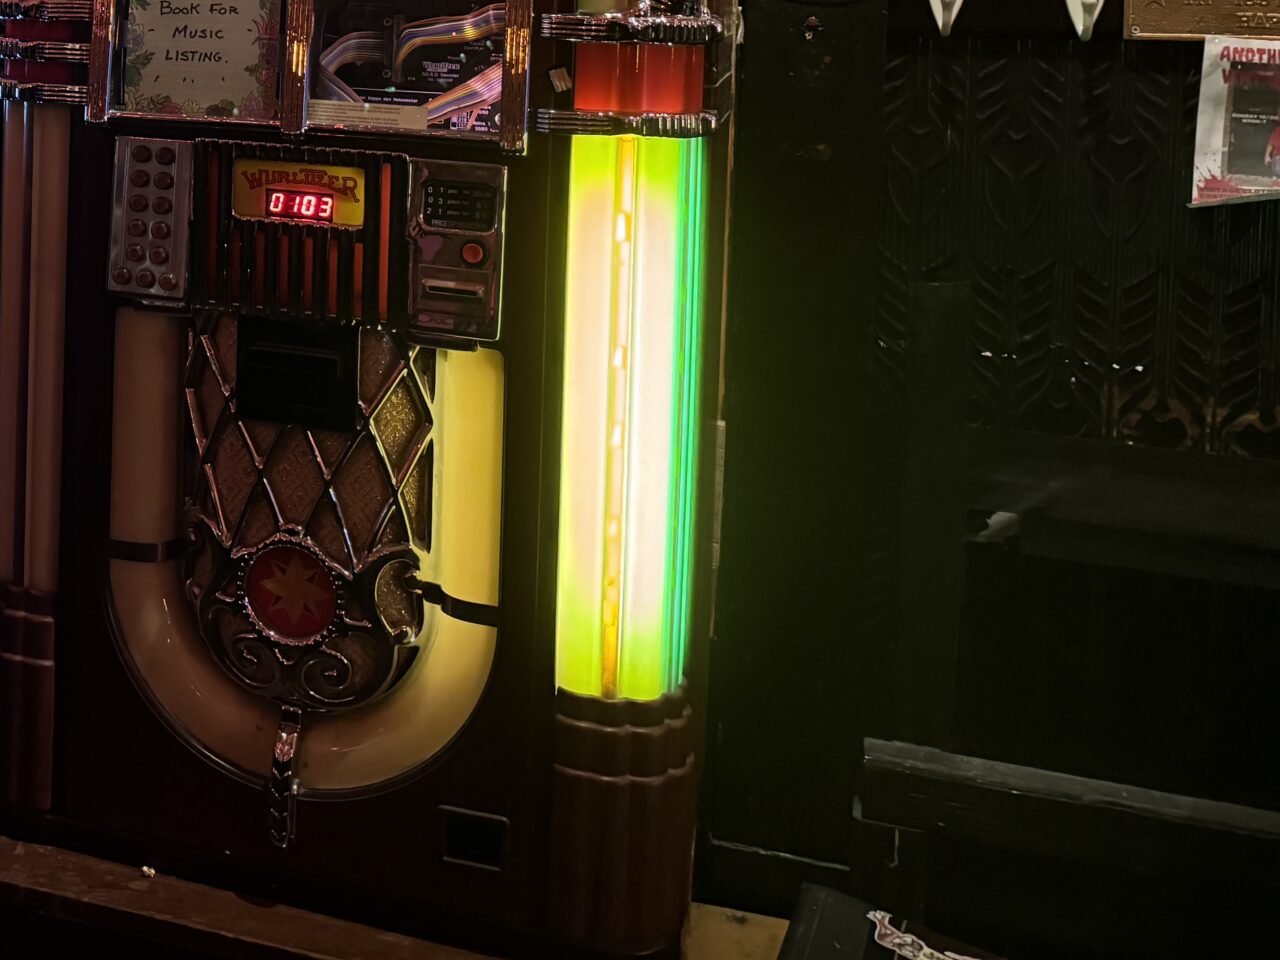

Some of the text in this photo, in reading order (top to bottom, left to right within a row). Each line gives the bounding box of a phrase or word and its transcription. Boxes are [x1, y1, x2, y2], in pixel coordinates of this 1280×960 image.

[209, 3, 239, 15] FOR
[172, 24, 224, 39] MUSIC
[165, 49, 228, 63] LISTING.
[1220, 46, 1280, 64] ANOTH
[241, 168, 360, 203] WURLITZER
[269, 193, 332, 217] 0103
